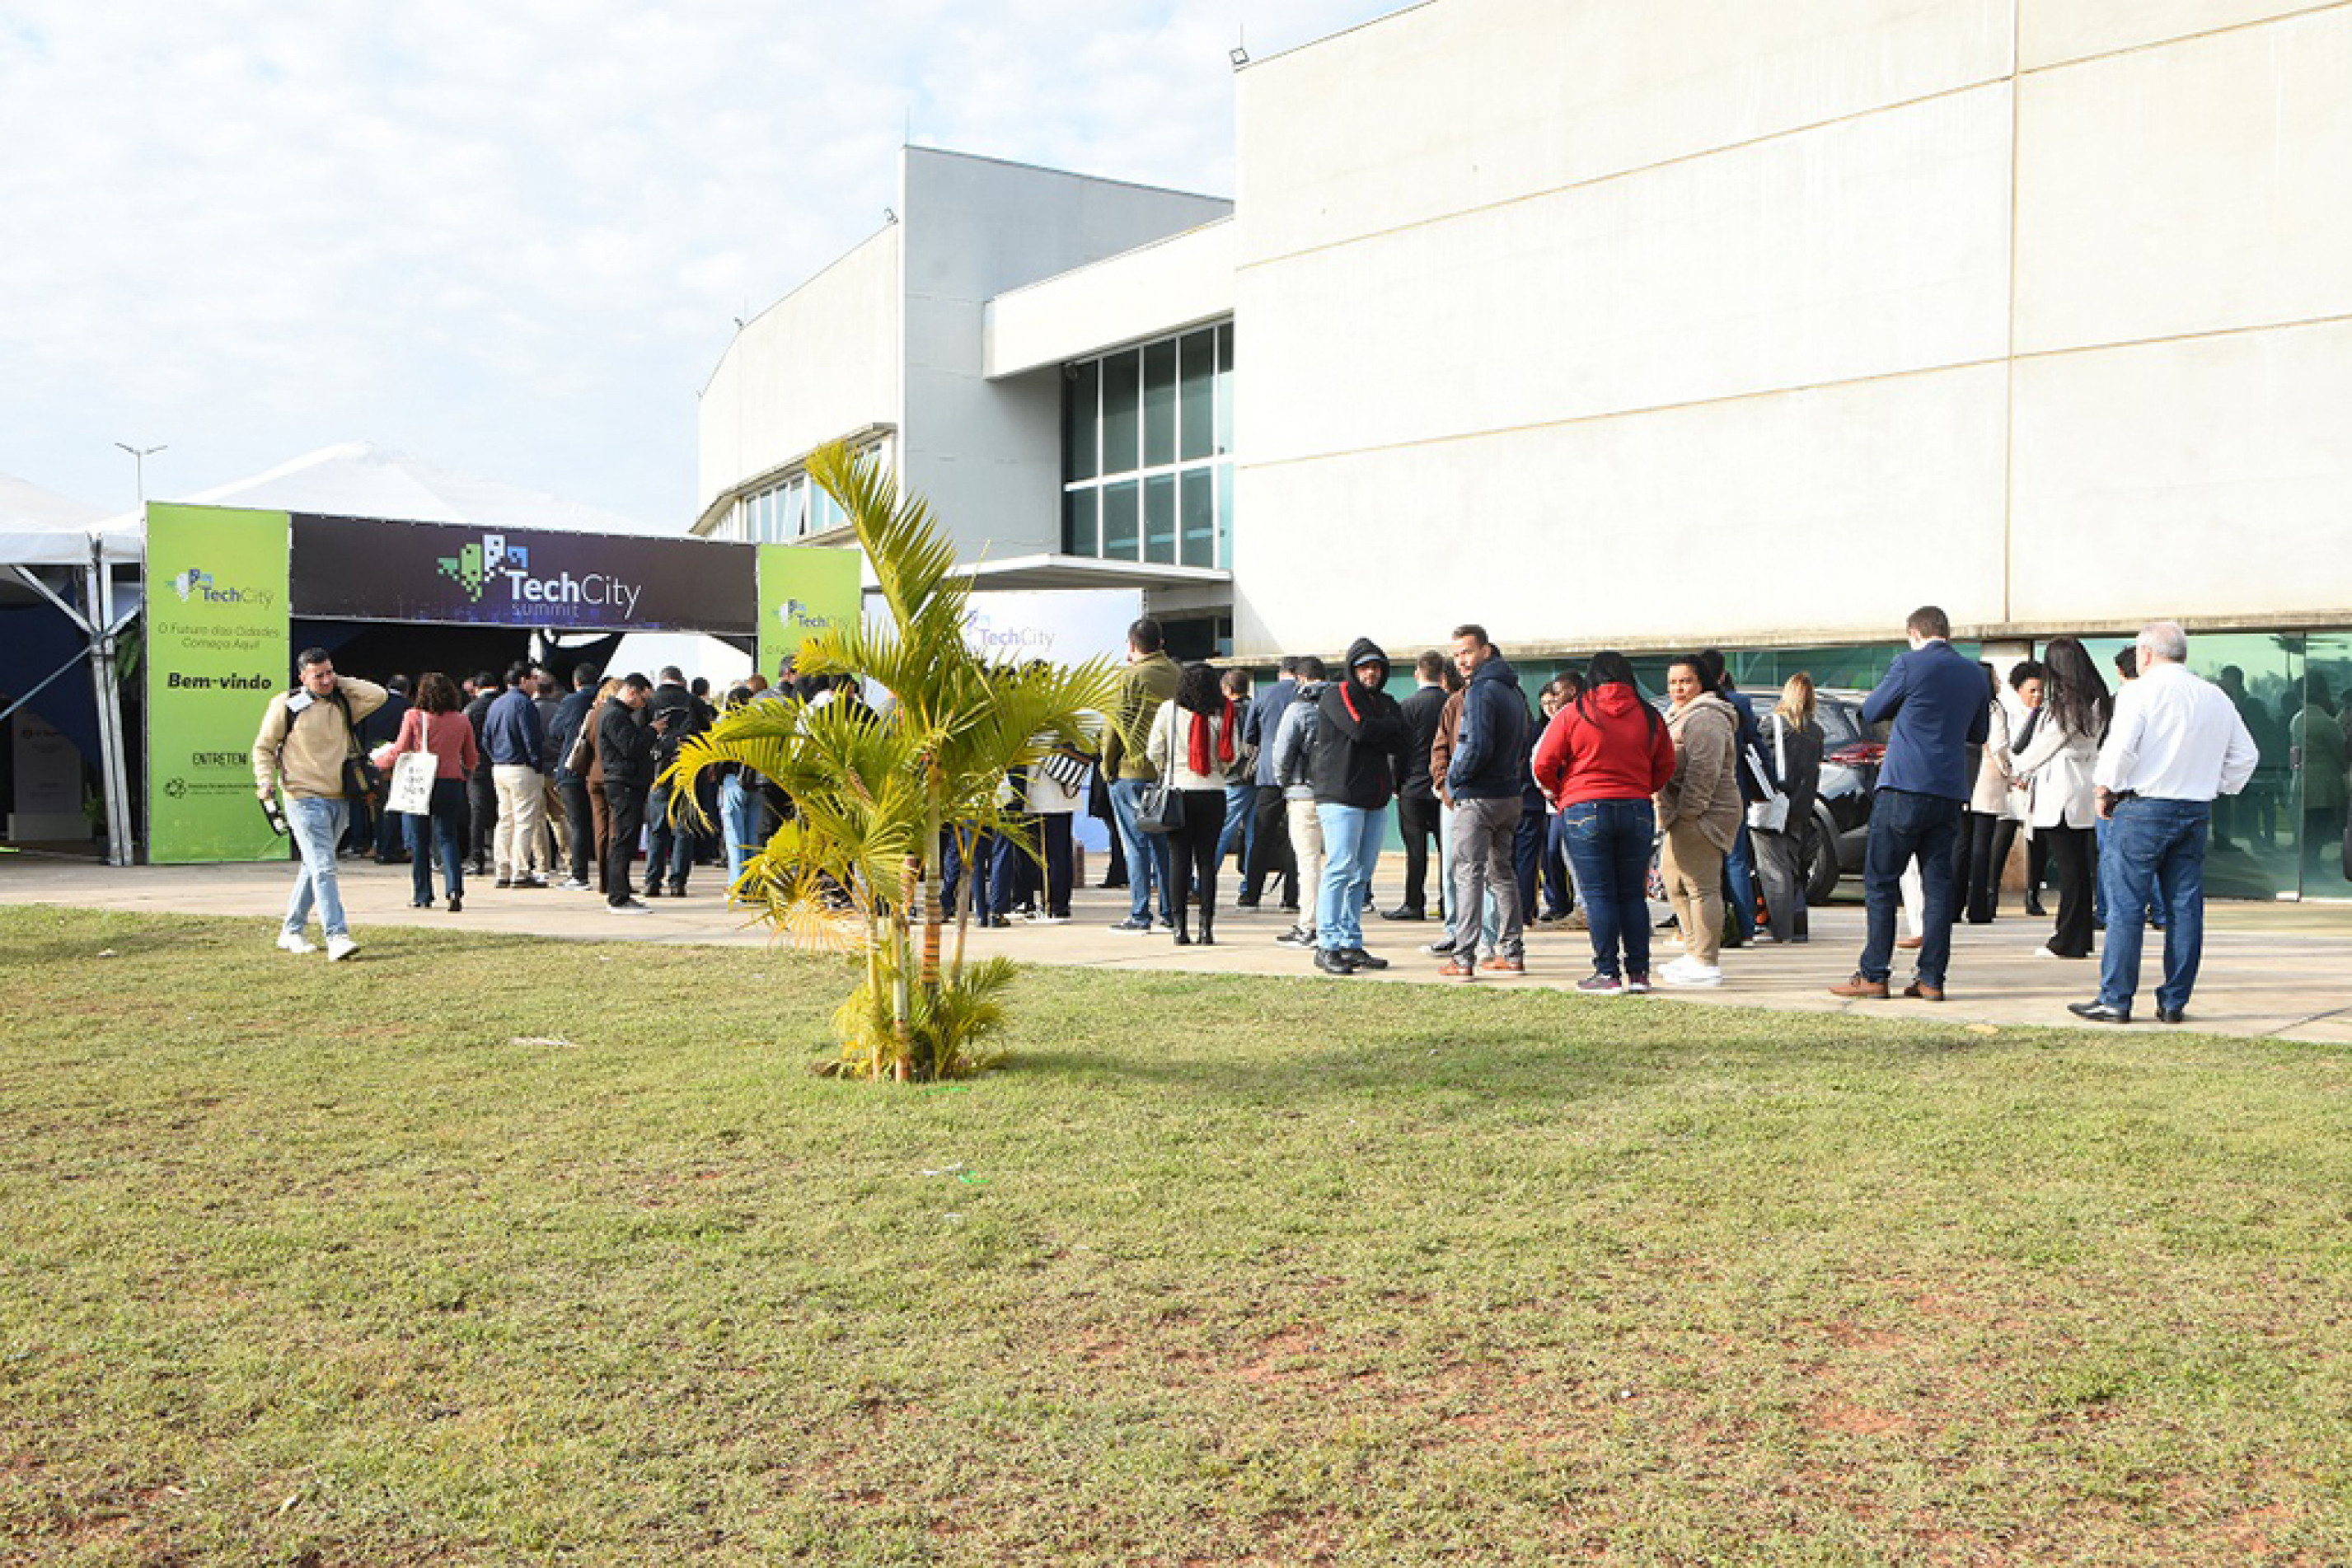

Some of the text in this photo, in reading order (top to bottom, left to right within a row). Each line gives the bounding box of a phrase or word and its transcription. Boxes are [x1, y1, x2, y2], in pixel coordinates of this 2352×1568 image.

[200, 586, 274, 610] TechCity
[505, 570, 641, 620] TechCity
[512, 602, 579, 617] summit
[158, 622, 168, 634] O
[170, 622, 208, 634] Futuro
[236, 625, 280, 639] Cidades
[978, 627, 1055, 652] TechCity
[167, 672, 272, 690] Bem-vindo
